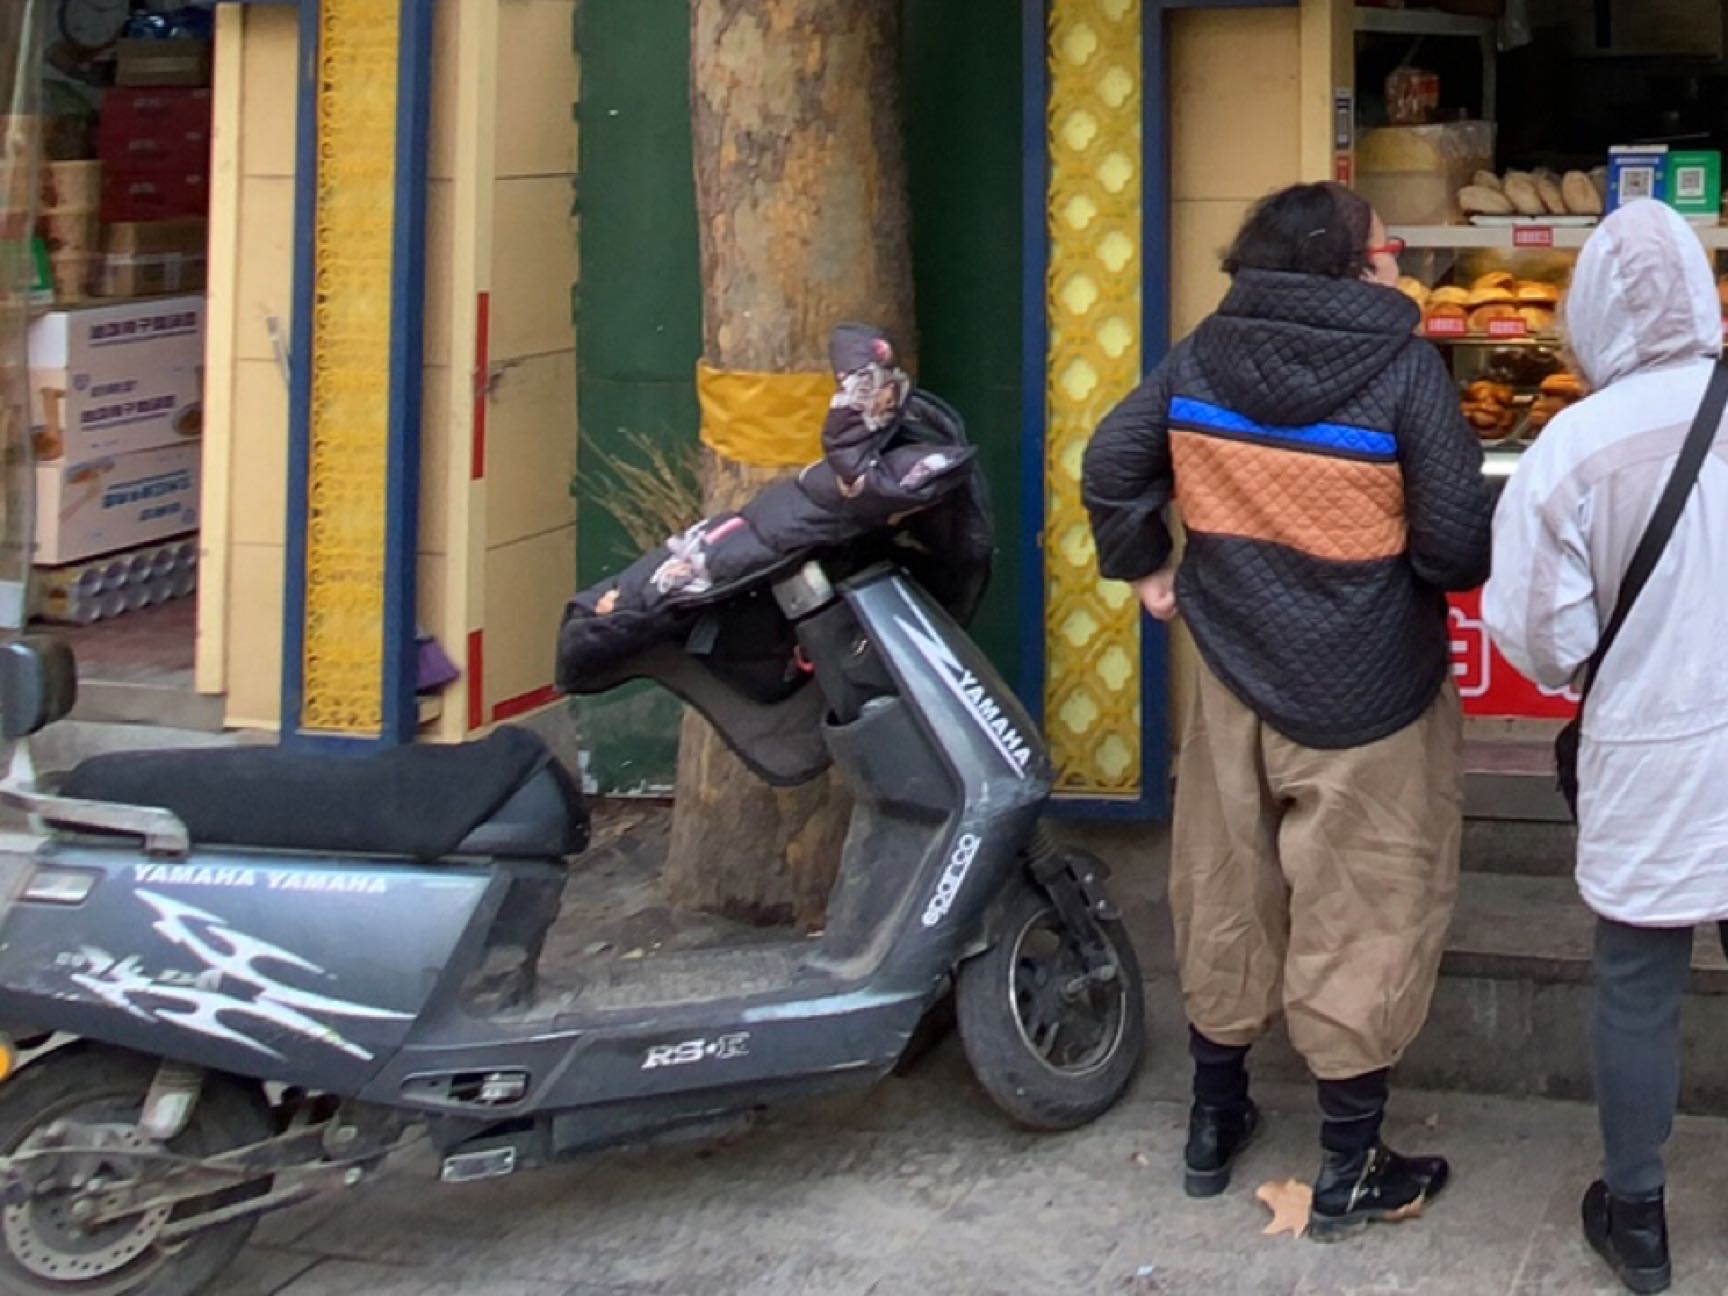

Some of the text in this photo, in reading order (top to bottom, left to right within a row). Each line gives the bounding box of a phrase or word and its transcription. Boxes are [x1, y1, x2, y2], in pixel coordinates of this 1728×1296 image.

[958, 669, 1033, 769] YAMAHA
[133, 862, 390, 895] YAMAHA YAMAHA
